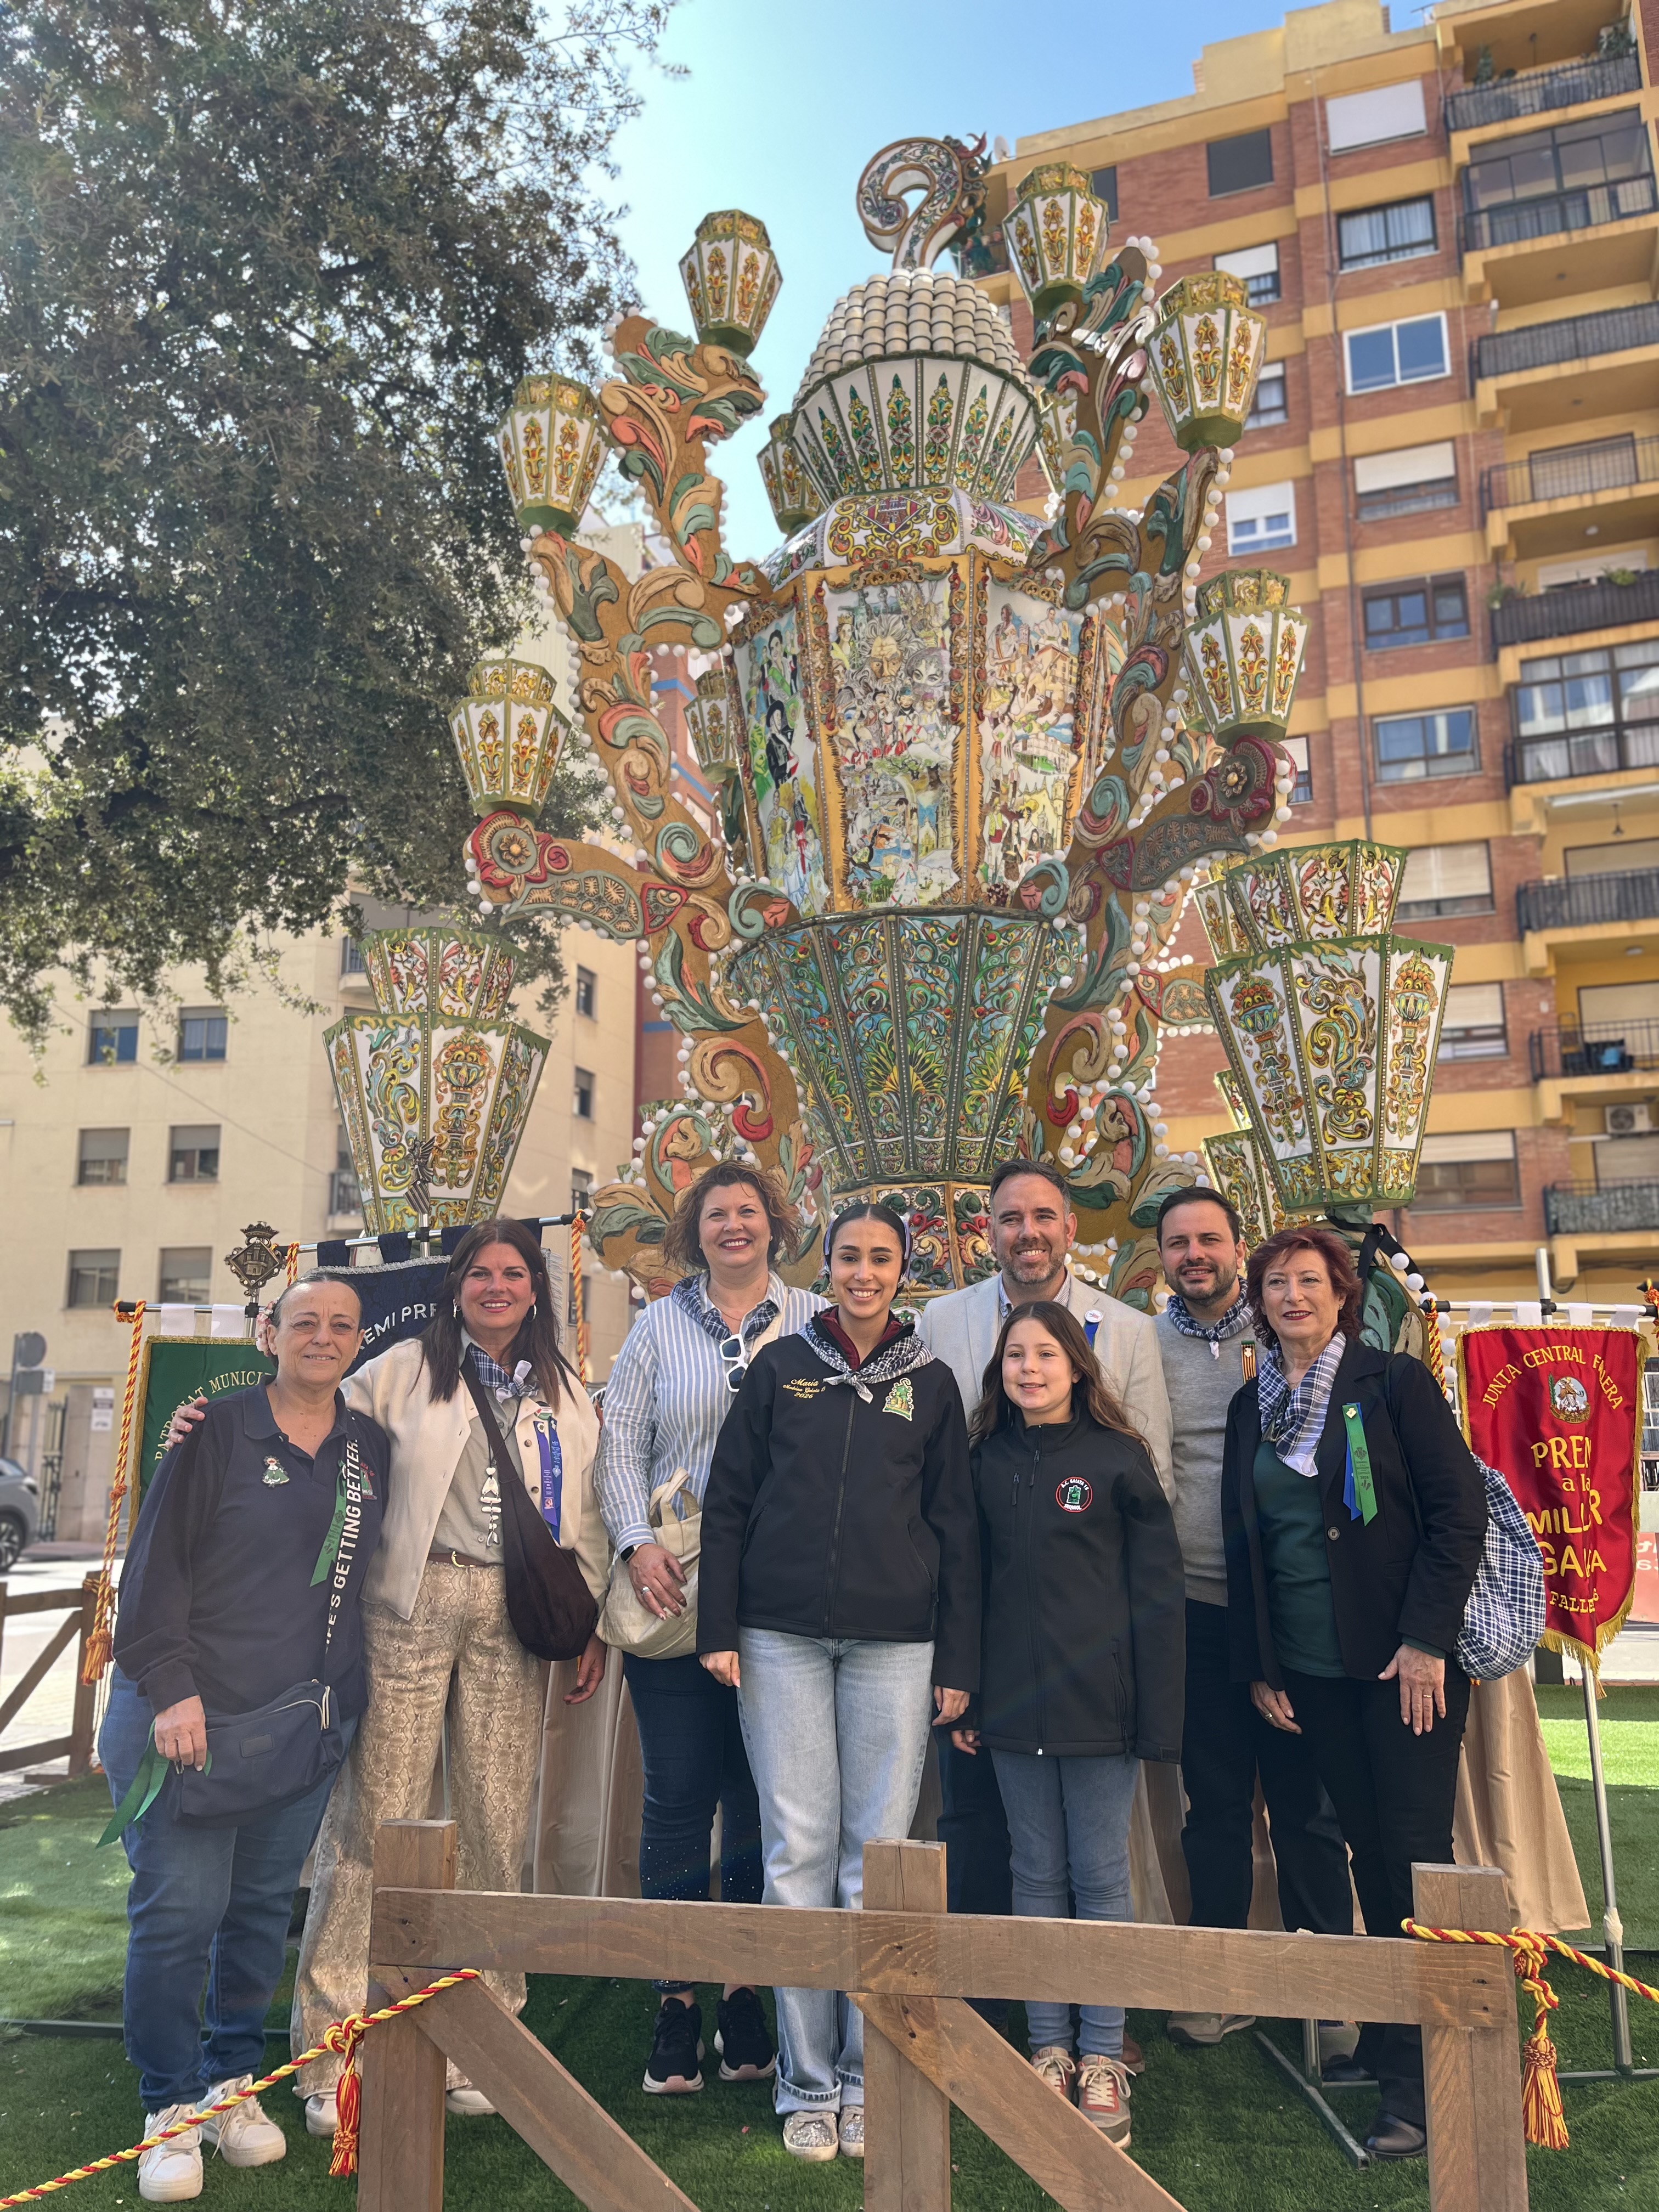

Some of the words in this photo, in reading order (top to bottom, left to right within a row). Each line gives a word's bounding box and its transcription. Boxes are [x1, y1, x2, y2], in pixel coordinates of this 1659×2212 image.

[359, 1312, 396, 1350] EMI
[208, 1371, 272, 1394] MUNICI
[1482, 1364, 1522, 1410] JUNTA
[1523, 1345, 1586, 1368] CENTRAL
[1593, 1354, 1623, 1410] FALERA
[346, 1439, 362, 1503] BETTER.
[1562, 1477, 1576, 1492] a
[1580, 1474, 1590, 1492] la
[1525, 1489, 1603, 1534] MILLR
[334, 1505, 361, 1589] GETTING
